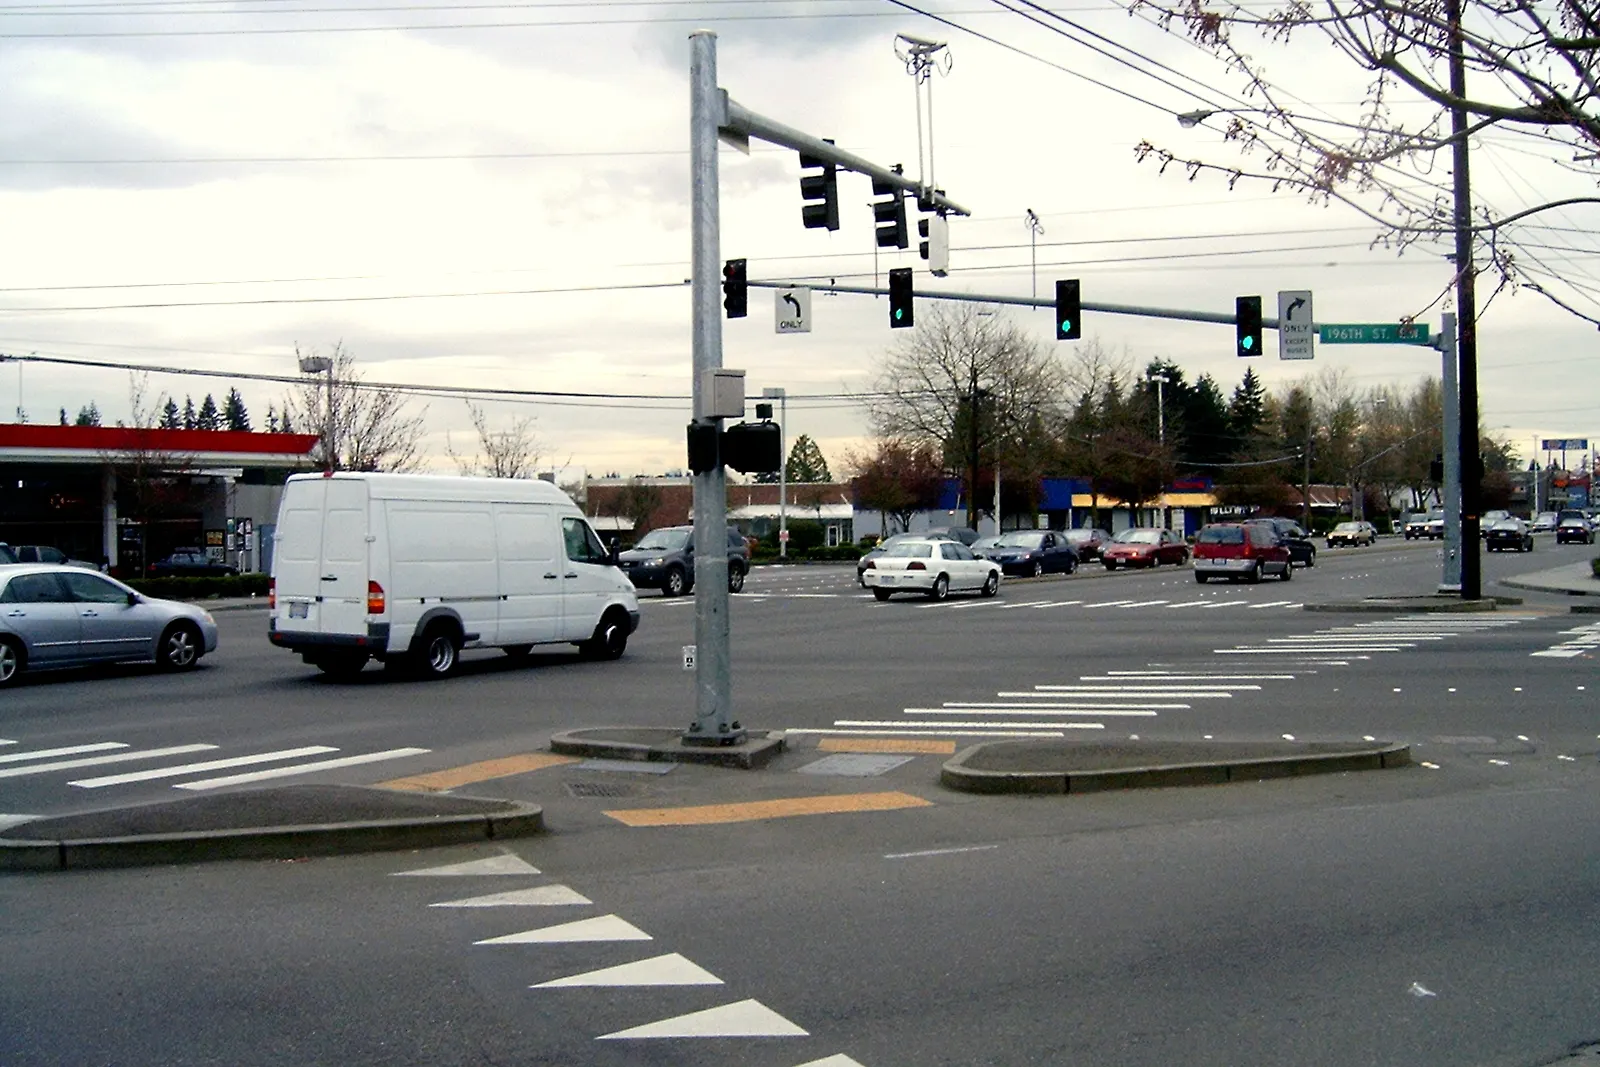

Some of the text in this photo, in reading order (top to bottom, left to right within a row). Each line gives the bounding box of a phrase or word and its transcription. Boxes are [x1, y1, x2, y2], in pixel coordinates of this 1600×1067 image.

[780, 320, 803, 329] ONLY
[1284, 324, 1308, 333] ONLY
[1328, 327, 1363, 339] 196TH
[1372, 327, 1390, 339] ST.
